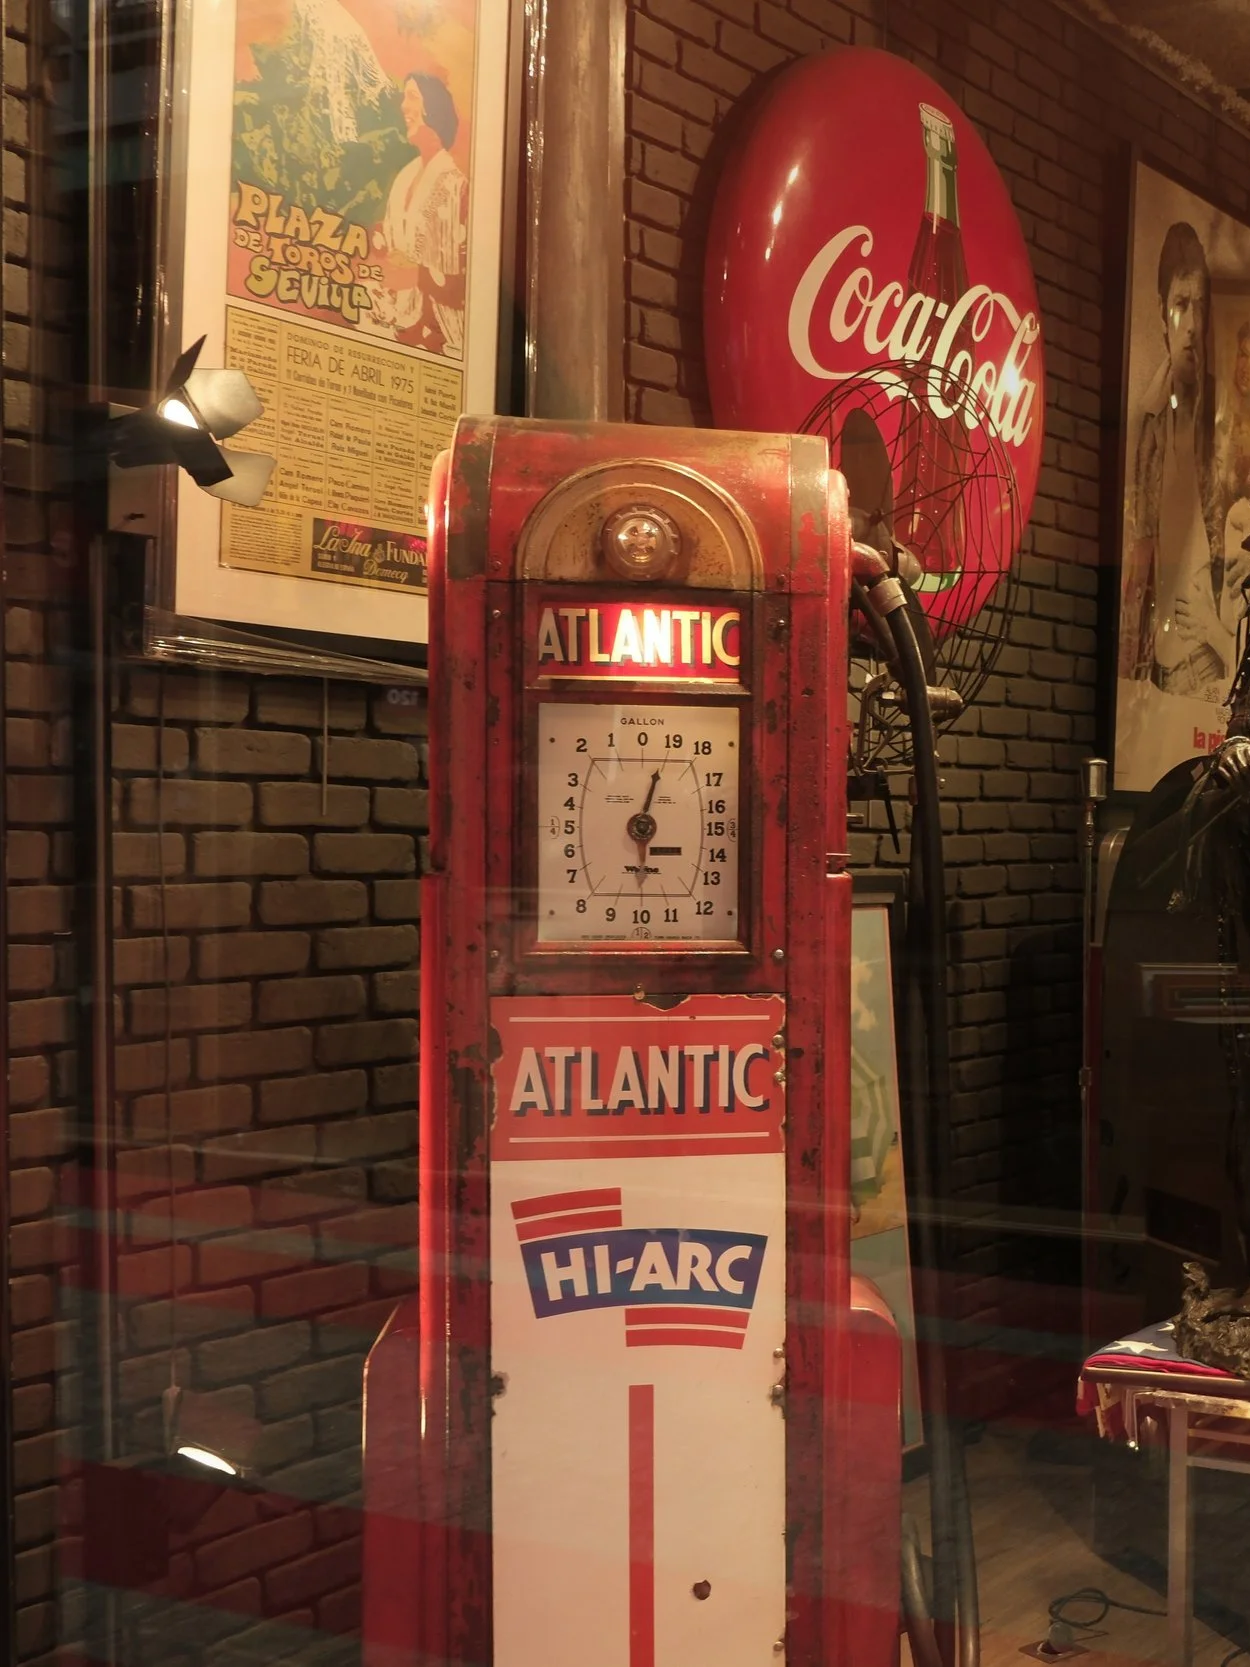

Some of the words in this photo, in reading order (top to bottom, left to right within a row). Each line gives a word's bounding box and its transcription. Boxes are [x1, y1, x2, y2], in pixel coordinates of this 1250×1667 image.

[233, 179, 369, 260] PLAZA
[233, 228, 263, 253] DE
[266, 237, 355, 285] TOROS
[357, 264, 384, 281] DE
[287, 332, 329, 351] DOMINGO
[333, 344, 344, 355] DE
[788, 224, 1039, 448] Coca-Cola
[287, 345, 322, 370] FERIA
[328, 356, 345, 376] DE
[351, 364, 385, 387] ABRIL
[391, 376, 414, 394] 1975
[313, 525, 339, 552] La
[537, 607, 740, 665] ATLANTIC
[620, 716, 665, 726] GALLON
[576, 738, 588, 753] 2
[607, 732, 616, 748] 1
[637, 732, 648, 747] 0
[664, 734, 683, 749] 19
[693, 741, 712, 756] 18
[1193, 726, 1206, 749] la
[567, 773, 579, 788] 3
[705, 773, 723, 788] 17
[563, 796, 575, 811] 4
[707, 800, 726, 814] 16
[564, 820, 575, 835] 5
[706, 821, 725, 837] 15
[564, 843, 575, 858] 6
[708, 848, 727, 863] 14
[567, 869, 576, 884] 7
[703, 871, 721, 886] 13
[576, 899, 587, 914] 8
[605, 907, 616, 922] 9
[632, 910, 651, 924] 10
[664, 908, 679, 923] 11
[695, 900, 714, 916] 12
[509, 1043, 767, 1114] ATLANTIC
[540, 1241, 753, 1302] HI-ARC
